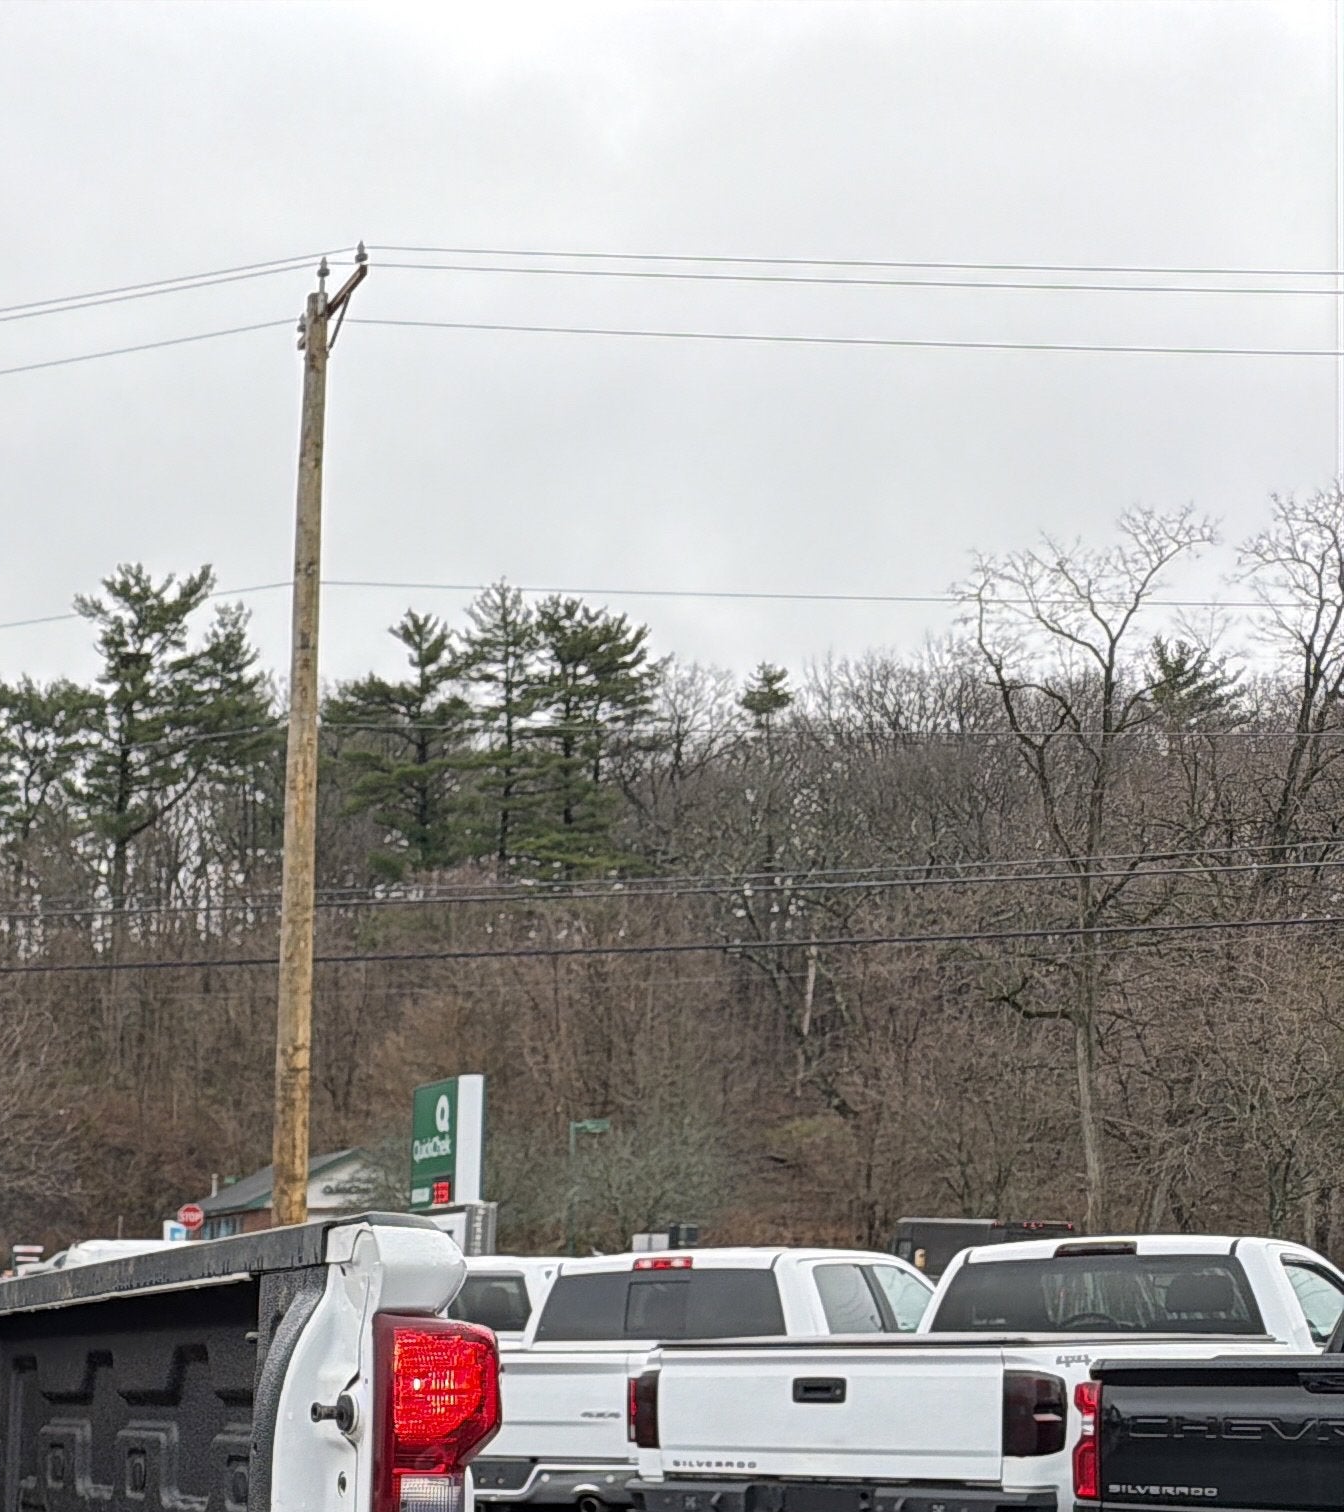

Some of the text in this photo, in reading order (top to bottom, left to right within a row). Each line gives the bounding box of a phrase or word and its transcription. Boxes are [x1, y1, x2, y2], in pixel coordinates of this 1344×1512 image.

[413, 1134, 452, 1164] QuickChek
[179, 1211, 203, 1222] STOP
[672, 1459, 757, 1469] SILVERADO
[1108, 1484, 1219, 1497] SILVERADO
